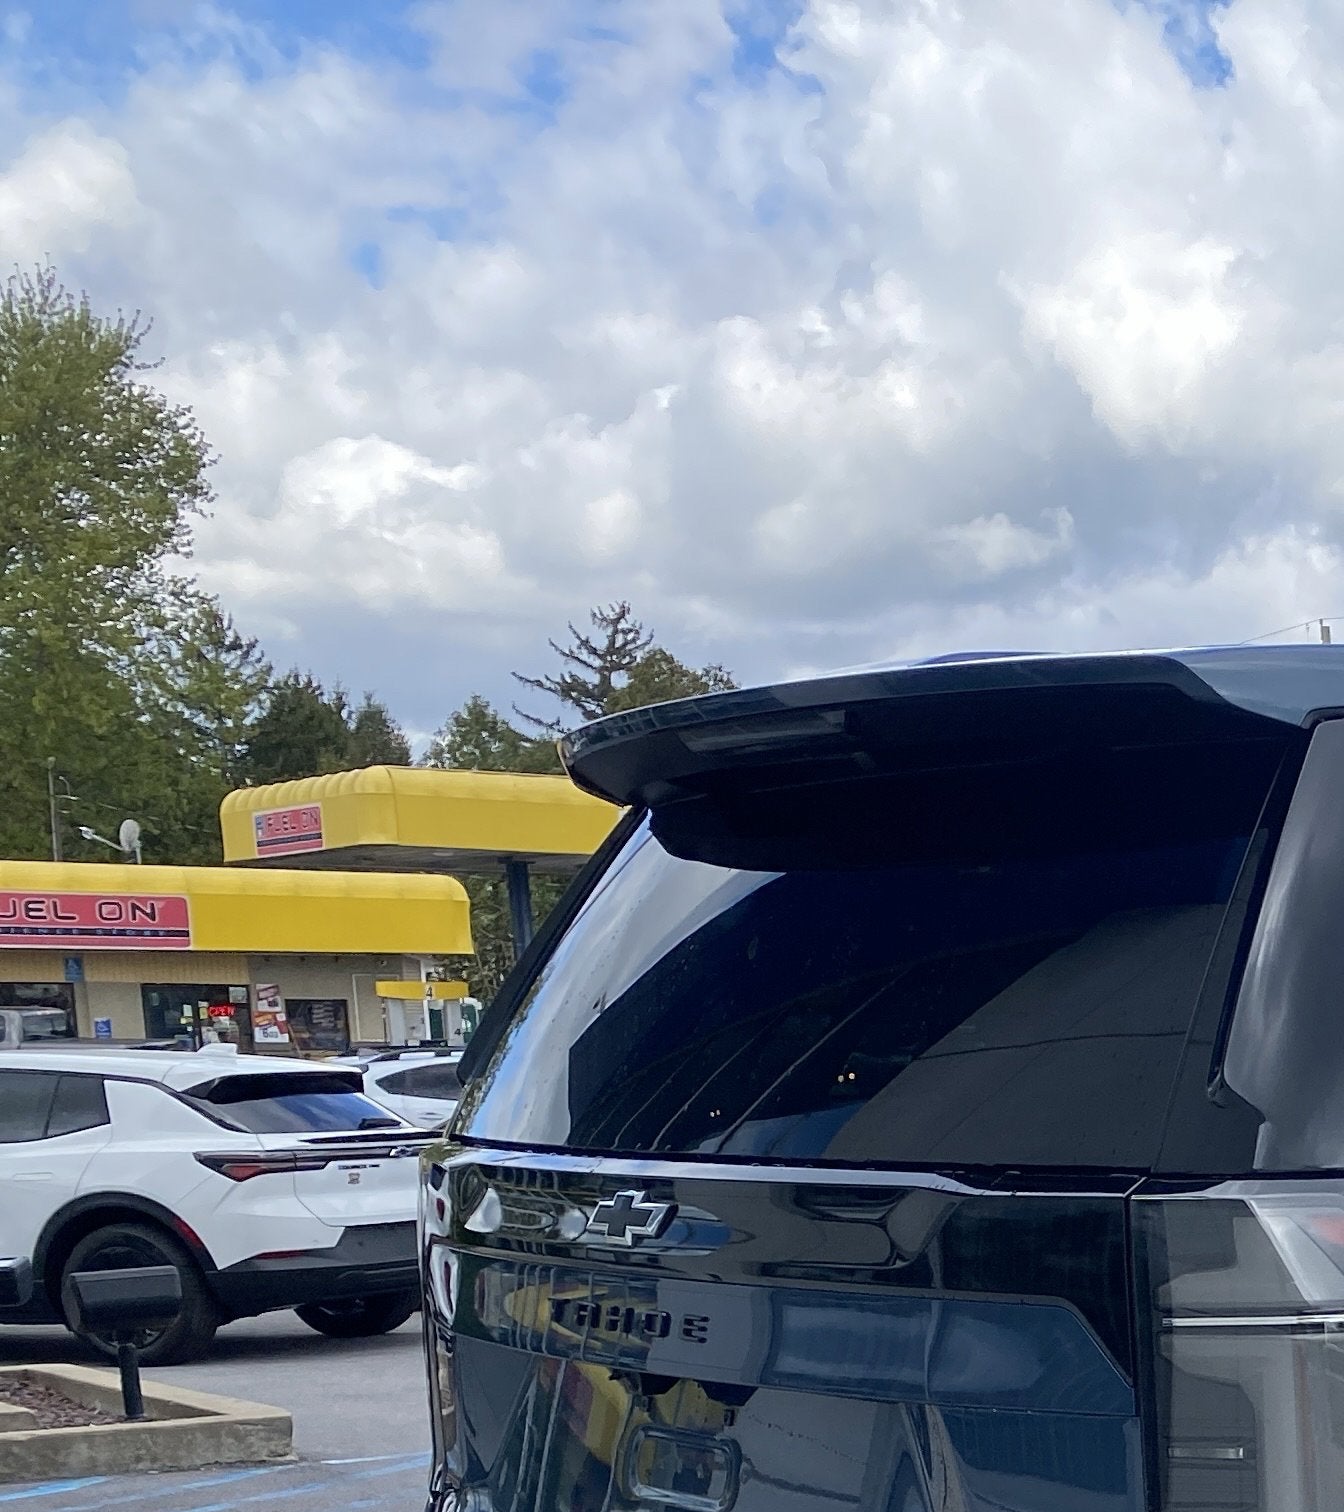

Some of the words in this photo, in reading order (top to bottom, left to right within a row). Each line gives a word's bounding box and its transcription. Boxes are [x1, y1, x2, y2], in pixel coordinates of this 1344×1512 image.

[98, 901, 157, 922] ON
[208, 1005, 236, 1017] OPEN
[548, 1297, 710, 1344] TAHOE
